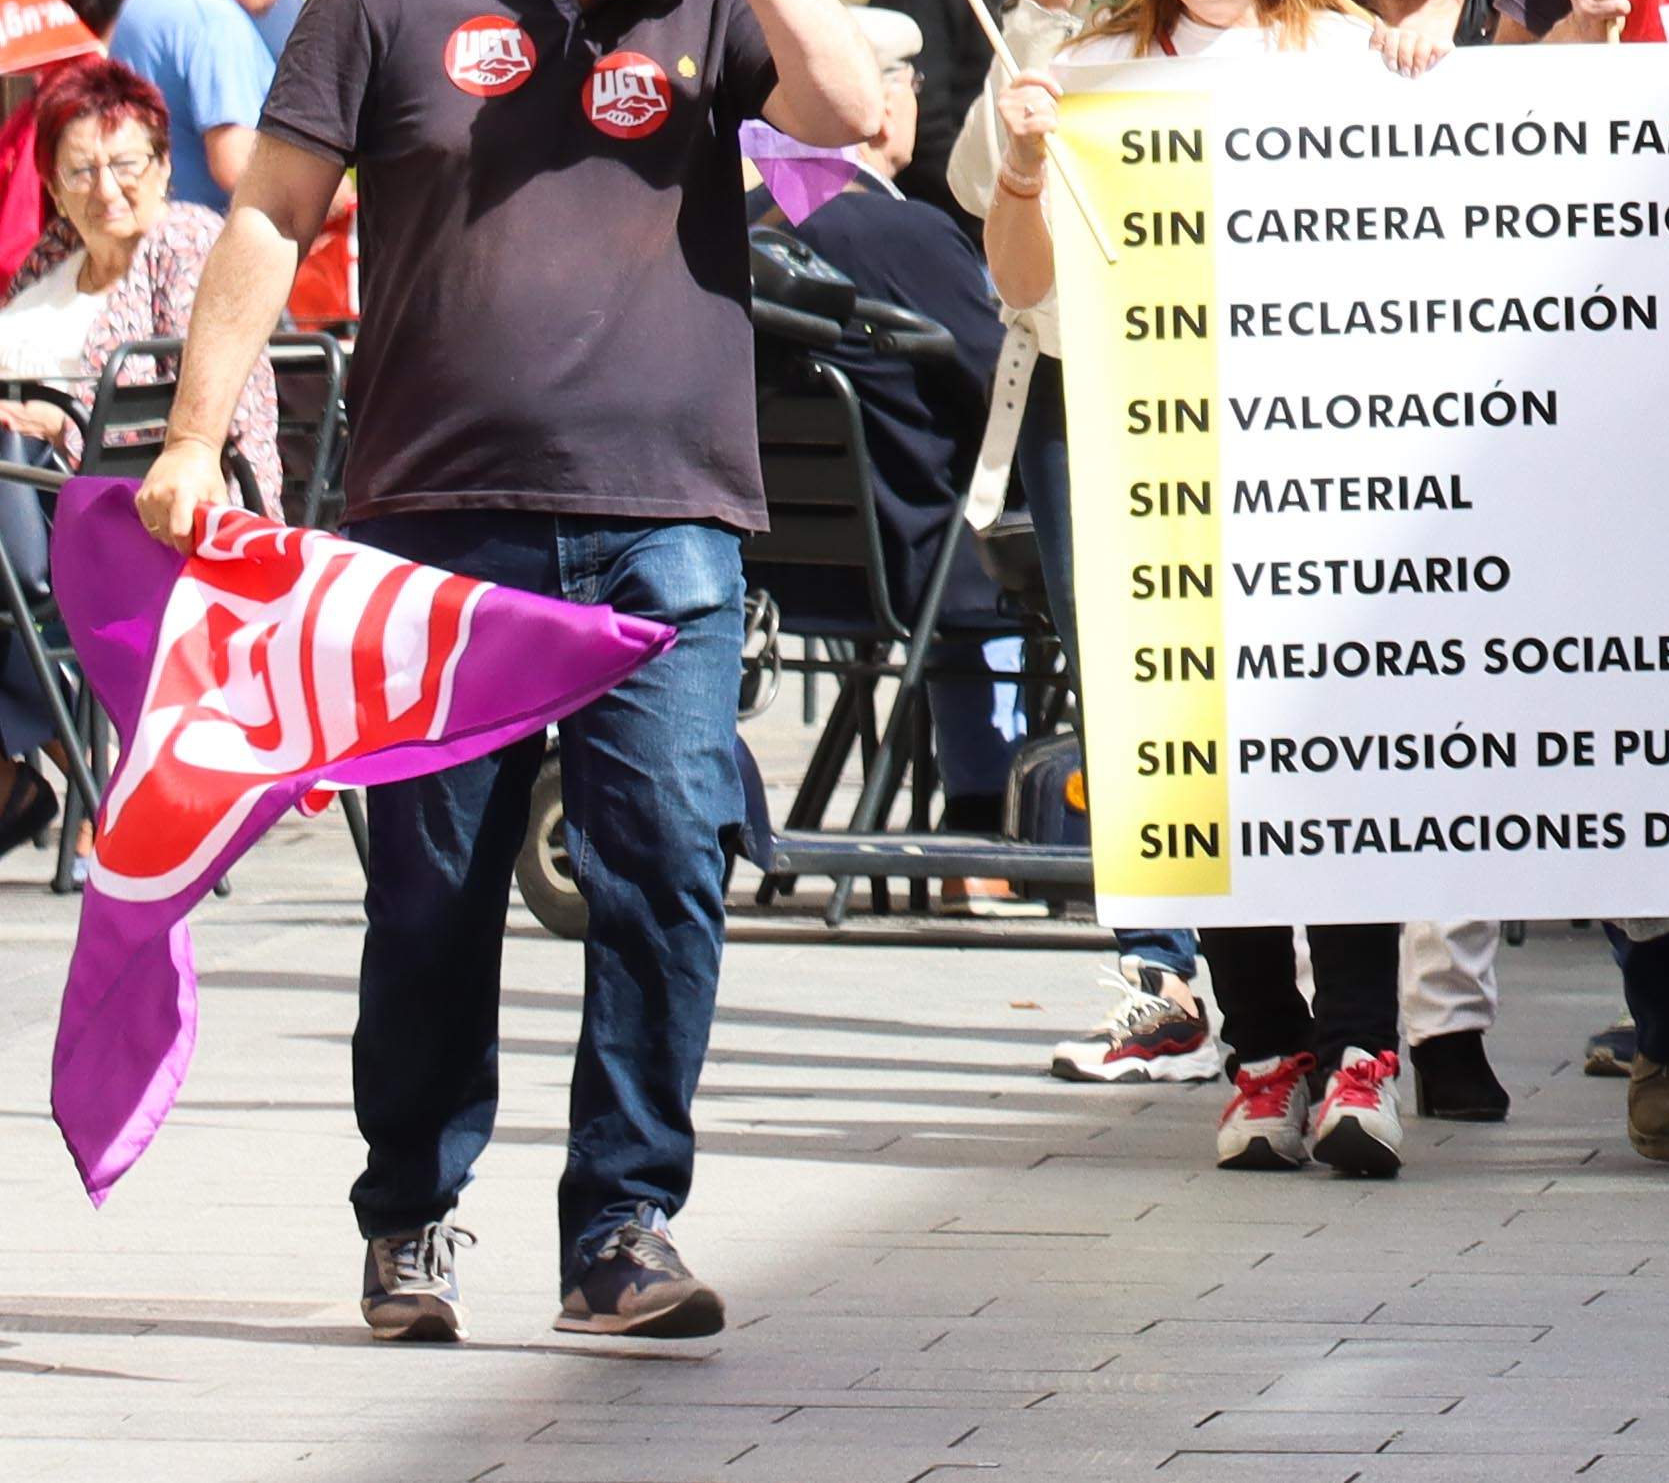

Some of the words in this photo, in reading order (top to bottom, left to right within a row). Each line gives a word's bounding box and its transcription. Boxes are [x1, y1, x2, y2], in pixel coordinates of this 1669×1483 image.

[455, 24, 531, 71] UGT
[592, 62, 667, 112] UGT
[1120, 129, 1204, 166] SIN
[1224, 109, 1588, 162] CONCILIACIÓN
[1122, 210, 1206, 248] SIN
[1225, 205, 1446, 245] CARRERA
[1125, 303, 1208, 342] SIN
[1229, 284, 1658, 338] RECLASIFICACIÓN
[1127, 397, 1210, 436] SIN
[1227, 379, 1558, 432] VALORACIÓN
[1129, 480, 1212, 518] SIN
[1232, 473, 1474, 515] MATERIAL
[1131, 563, 1214, 601] SIN
[1231, 554, 1512, 597] VESTUARIO
[1133, 645, 1216, 683] SIN
[1235, 637, 1467, 680] MEJORAS
[1136, 739, 1218, 778] SIN
[1238, 721, 1518, 775] PROVISIÓN
[1536, 729, 1596, 769] DE
[1139, 821, 1221, 860] SIN
[1240, 811, 1627, 858] INSTALACIONES
